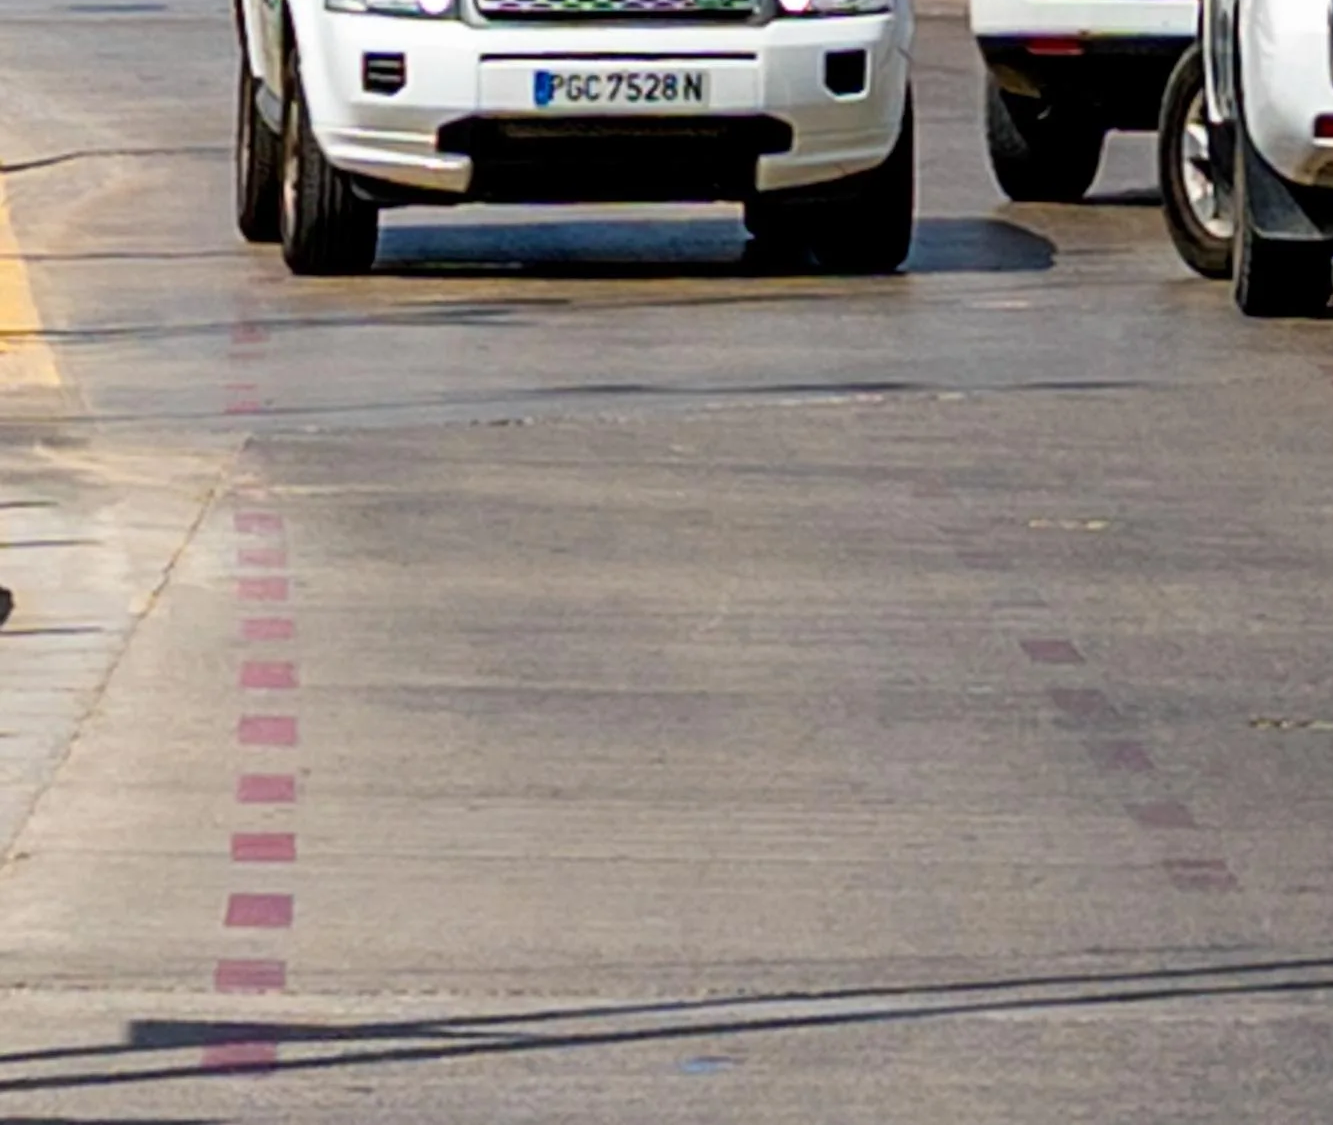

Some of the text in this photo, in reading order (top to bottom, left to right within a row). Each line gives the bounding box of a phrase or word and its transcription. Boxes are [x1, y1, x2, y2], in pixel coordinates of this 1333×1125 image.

[550, 72, 703, 102] PGC 7528 N
